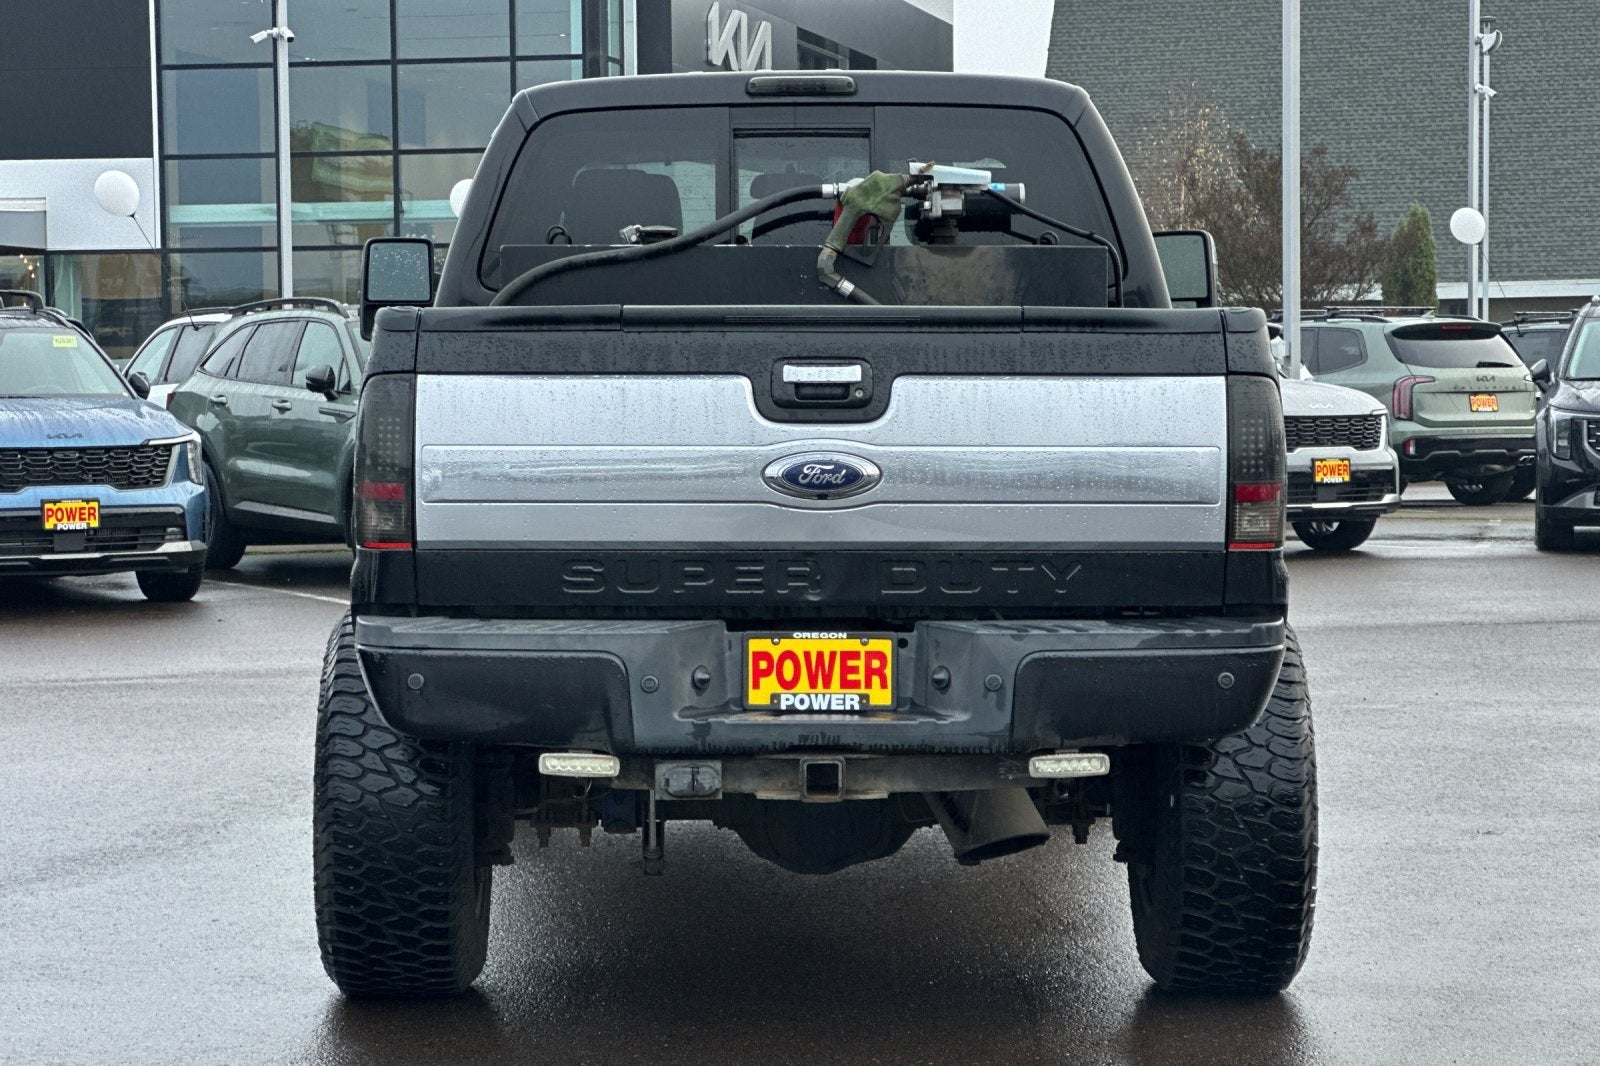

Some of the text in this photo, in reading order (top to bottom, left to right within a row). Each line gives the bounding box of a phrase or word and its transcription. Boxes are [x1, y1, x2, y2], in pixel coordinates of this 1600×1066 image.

[1472, 397, 1496, 406] POWER
[799, 463, 846, 484] Ford
[1316, 464, 1348, 477] POWER
[45, 506, 97, 522] POWER
[562, 559, 1081, 593] SUPER DUTY
[752, 650, 888, 690] POWER
[780, 694, 860, 710] POWER
